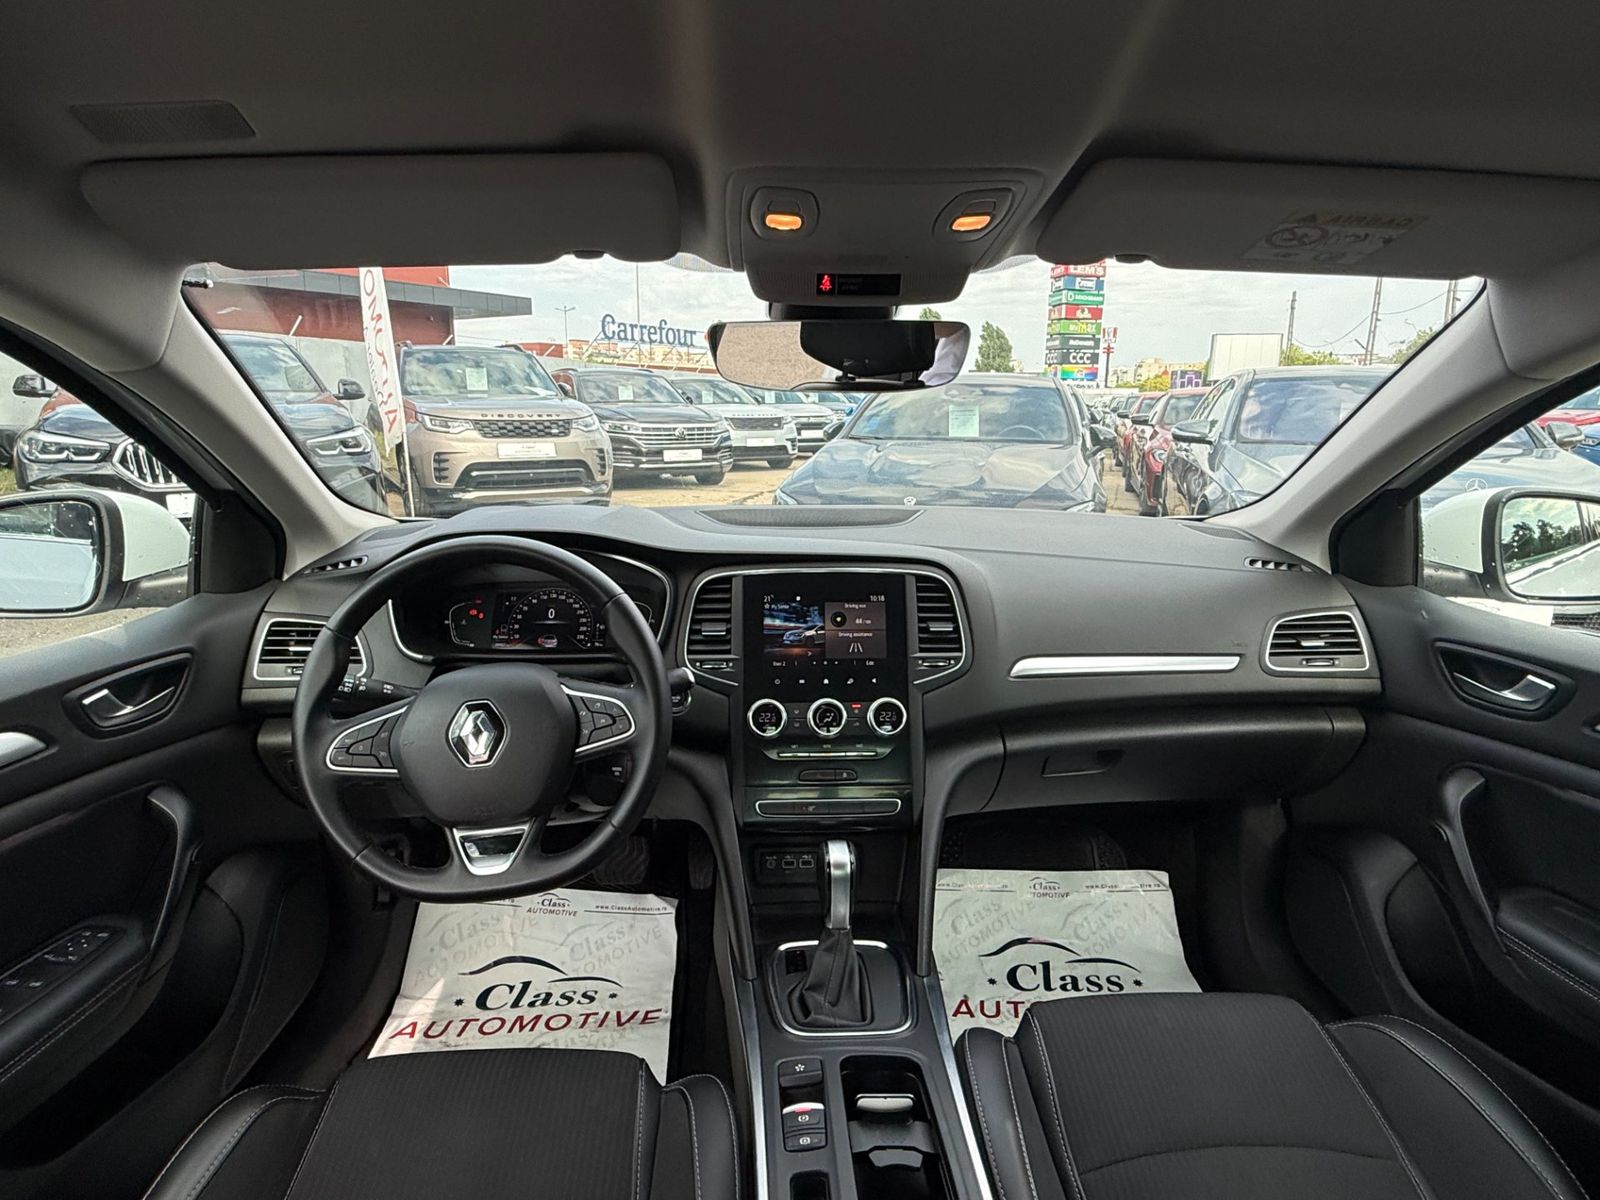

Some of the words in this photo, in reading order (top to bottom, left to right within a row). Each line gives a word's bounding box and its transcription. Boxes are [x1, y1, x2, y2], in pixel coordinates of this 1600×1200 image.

[1070, 265, 1104, 276] LEM'S
[601, 313, 697, 347] Carrefour
[1069, 352, 1092, 364] CCC
[870, 594, 885, 602] 10:18
[548, 608, 555, 619] 0
[1032, 881, 1058, 891] Class
[541, 897, 568, 908] Class
[526, 908, 578, 917] AUTOMOTIVE
[949, 899, 1003, 936] Class
[569, 927, 627, 963] Class
[1006, 960, 1125, 993] Class
[475, 980, 598, 1011] Class
[388, 1008, 664, 1040] AUTOMOTIVE
